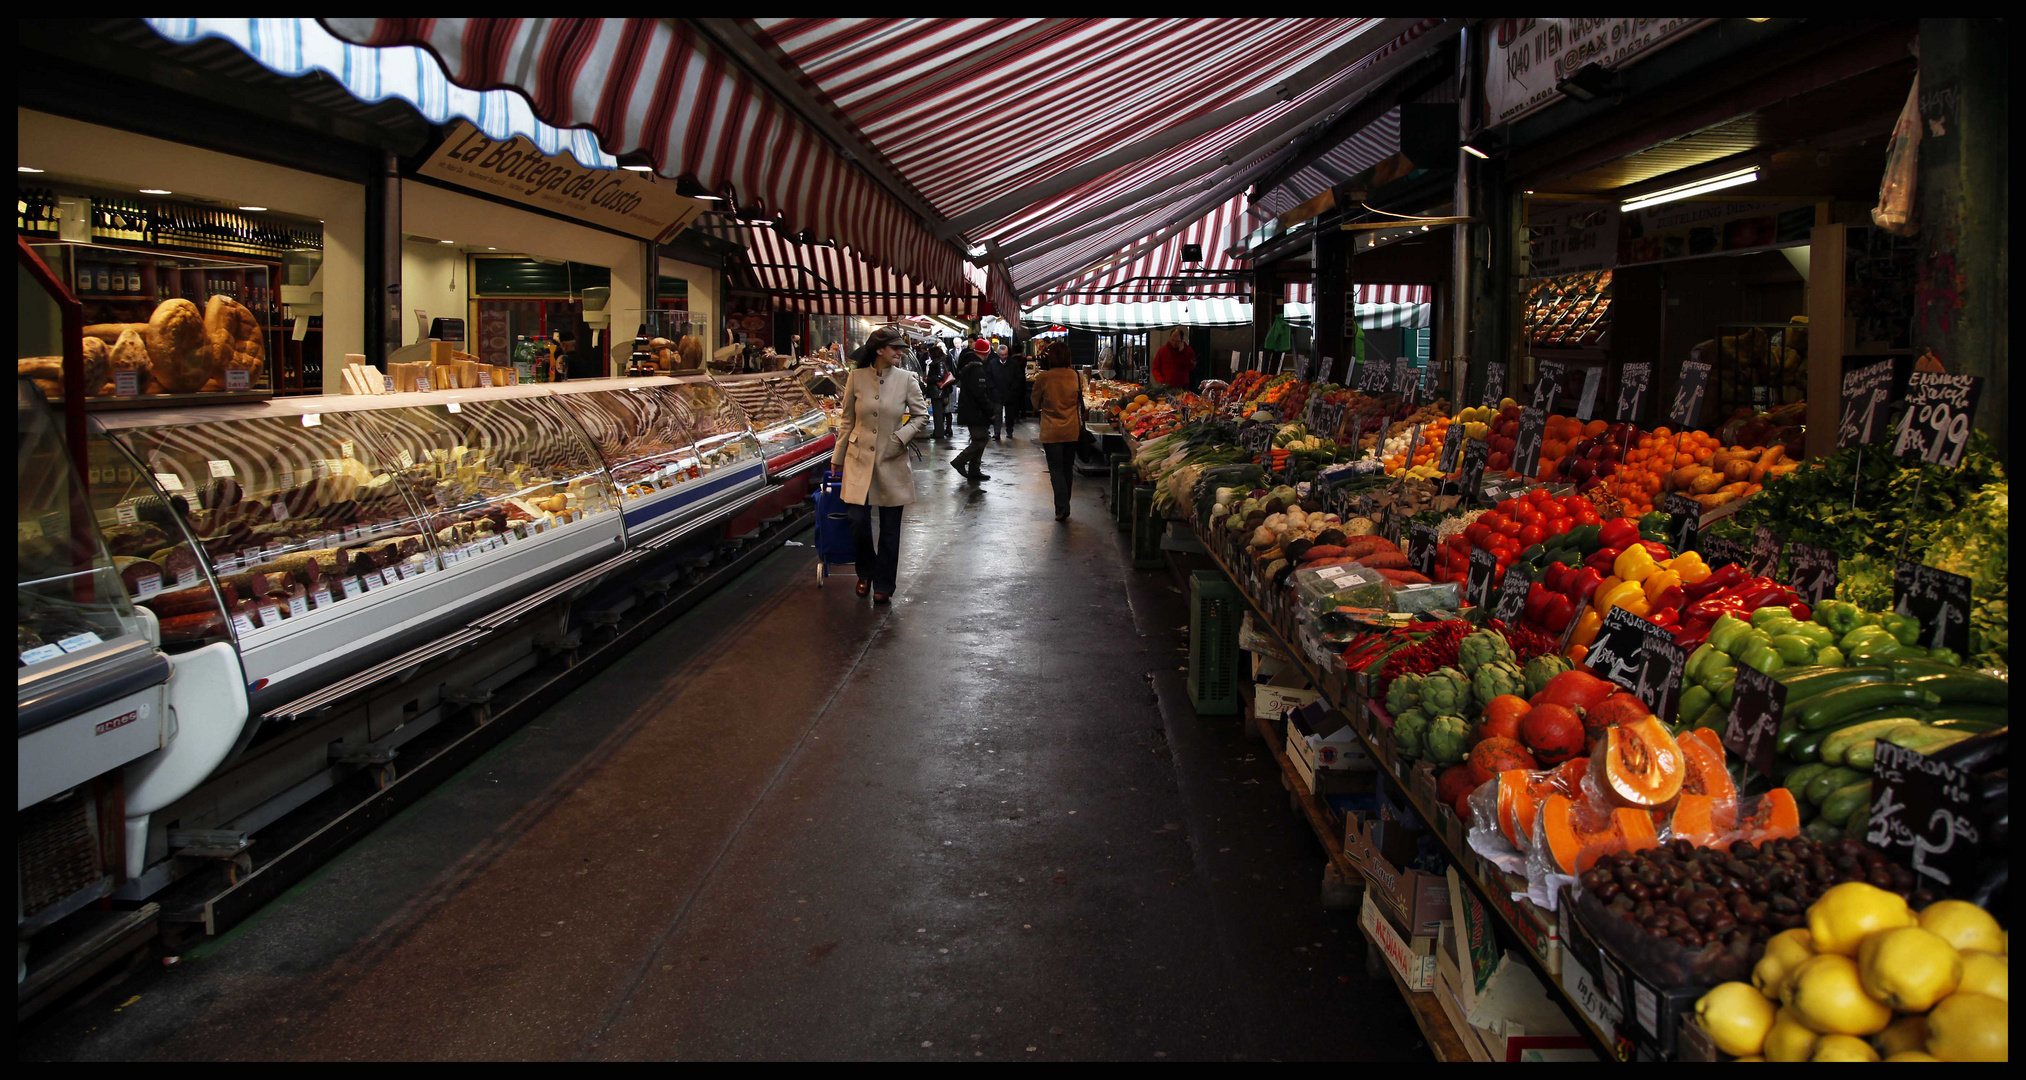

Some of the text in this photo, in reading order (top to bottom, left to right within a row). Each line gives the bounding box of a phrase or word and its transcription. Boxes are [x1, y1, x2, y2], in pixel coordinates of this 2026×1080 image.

[1535, 23, 1562, 65] WIEN
[447, 130, 491, 163] La
[479, 136, 572, 197] Bottega
[563, 169, 610, 200] del
[1656, 207, 1721, 229] ZUSTELLUNG
[1375, 918, 1409, 976] MEDIANA
